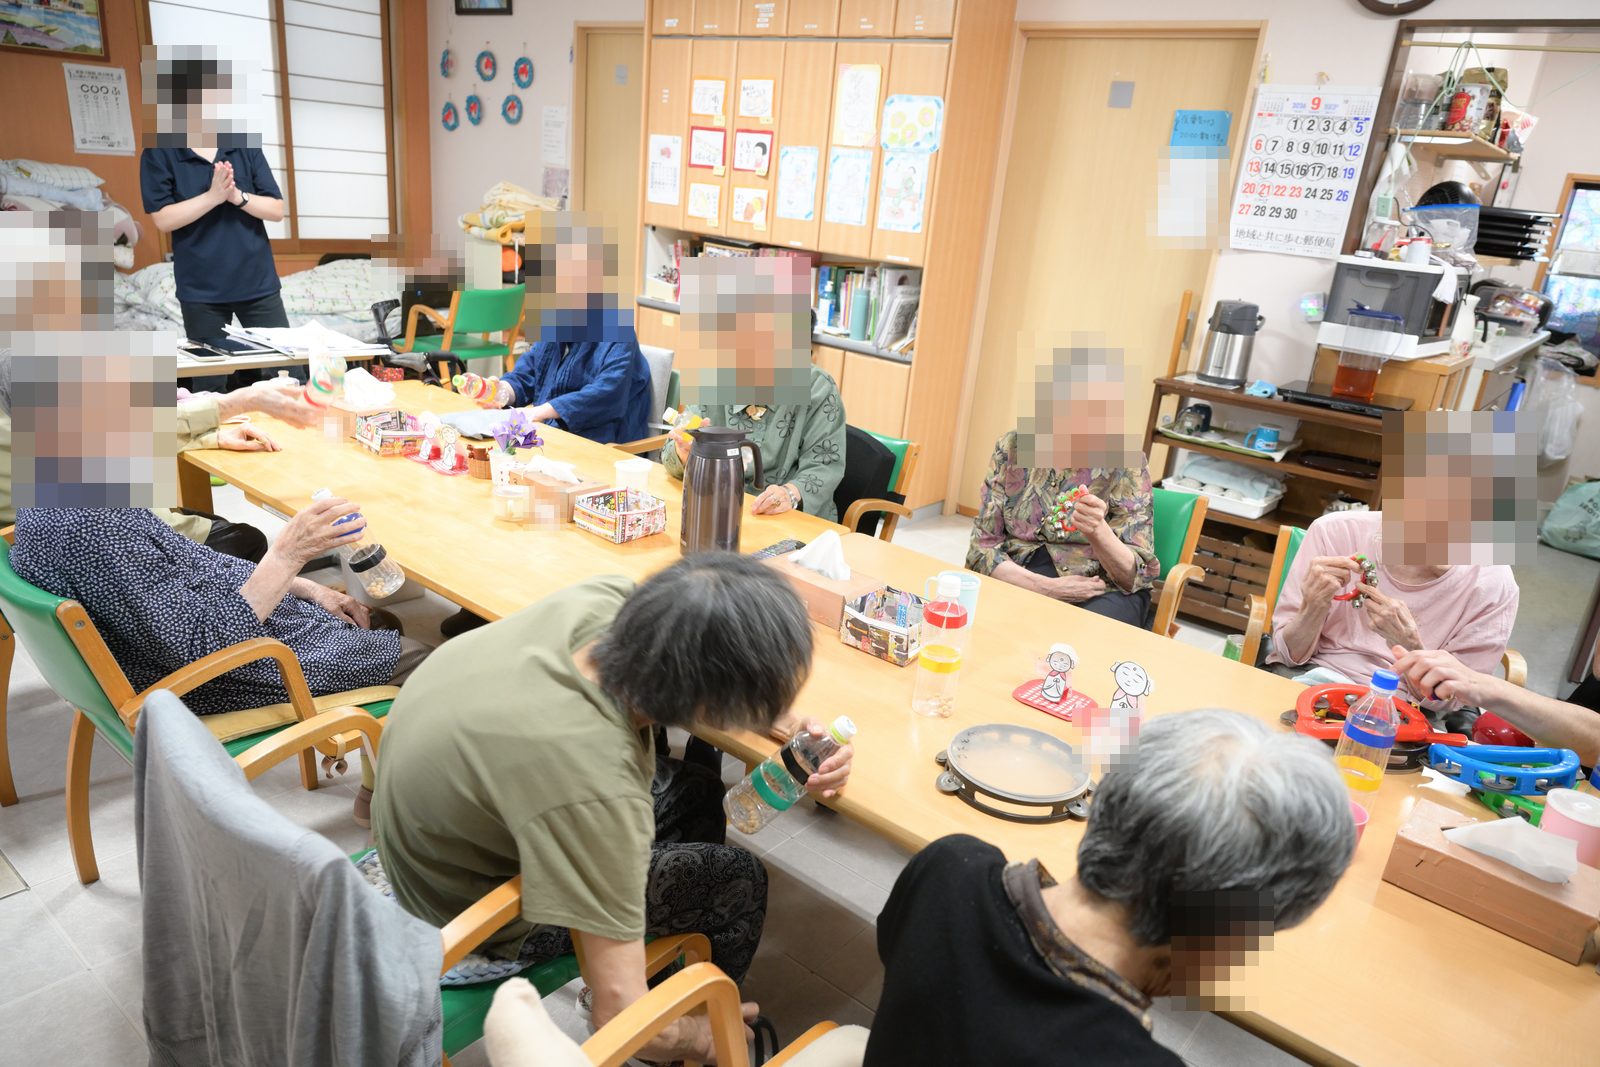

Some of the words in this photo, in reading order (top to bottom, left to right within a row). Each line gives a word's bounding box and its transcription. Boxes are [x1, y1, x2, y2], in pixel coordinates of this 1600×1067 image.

[1310, 96, 1322, 111] 9
[1292, 118, 1300, 131] 1
[1306, 119, 1317, 132] 2
[1323, 120, 1331, 132] 3
[1338, 119, 1348, 133] 4
[1354, 121, 1364, 134] 5
[1254, 138, 1264, 151] 6
[1271, 140, 1280, 152] 7
[1285, 140, 1294, 153] 8
[1301, 141, 1310, 154] 9
[1315, 142, 1328, 155] 10
[1332, 143, 1344, 155] 11
[1347, 144, 1362, 157] 12
[1248, 160, 1260, 173] 13
[1264, 162, 1276, 173] 14
[1280, 163, 1292, 176] 15
[1295, 164, 1307, 176] 16
[1310, 165, 1323, 177] 17
[1326, 166, 1338, 178] 18
[1342, 167, 1355, 180] 19
[1242, 182, 1256, 195] 20
[1258, 183, 1271, 196] 21
[1273, 184, 1287, 197] 22
[1289, 186, 1302, 198] 23
[1304, 187, 1318, 199] 24
[1320, 188, 1333, 201] 25
[1335, 189, 1350, 202] 26
[1238, 203, 1251, 215] 27
[1253, 205, 1266, 217] 28
[1268, 206, 1282, 218] 29
[1284, 207, 1298, 220] 30
[1234, 227, 1336, 249] 地域と共に歩む郵便局
